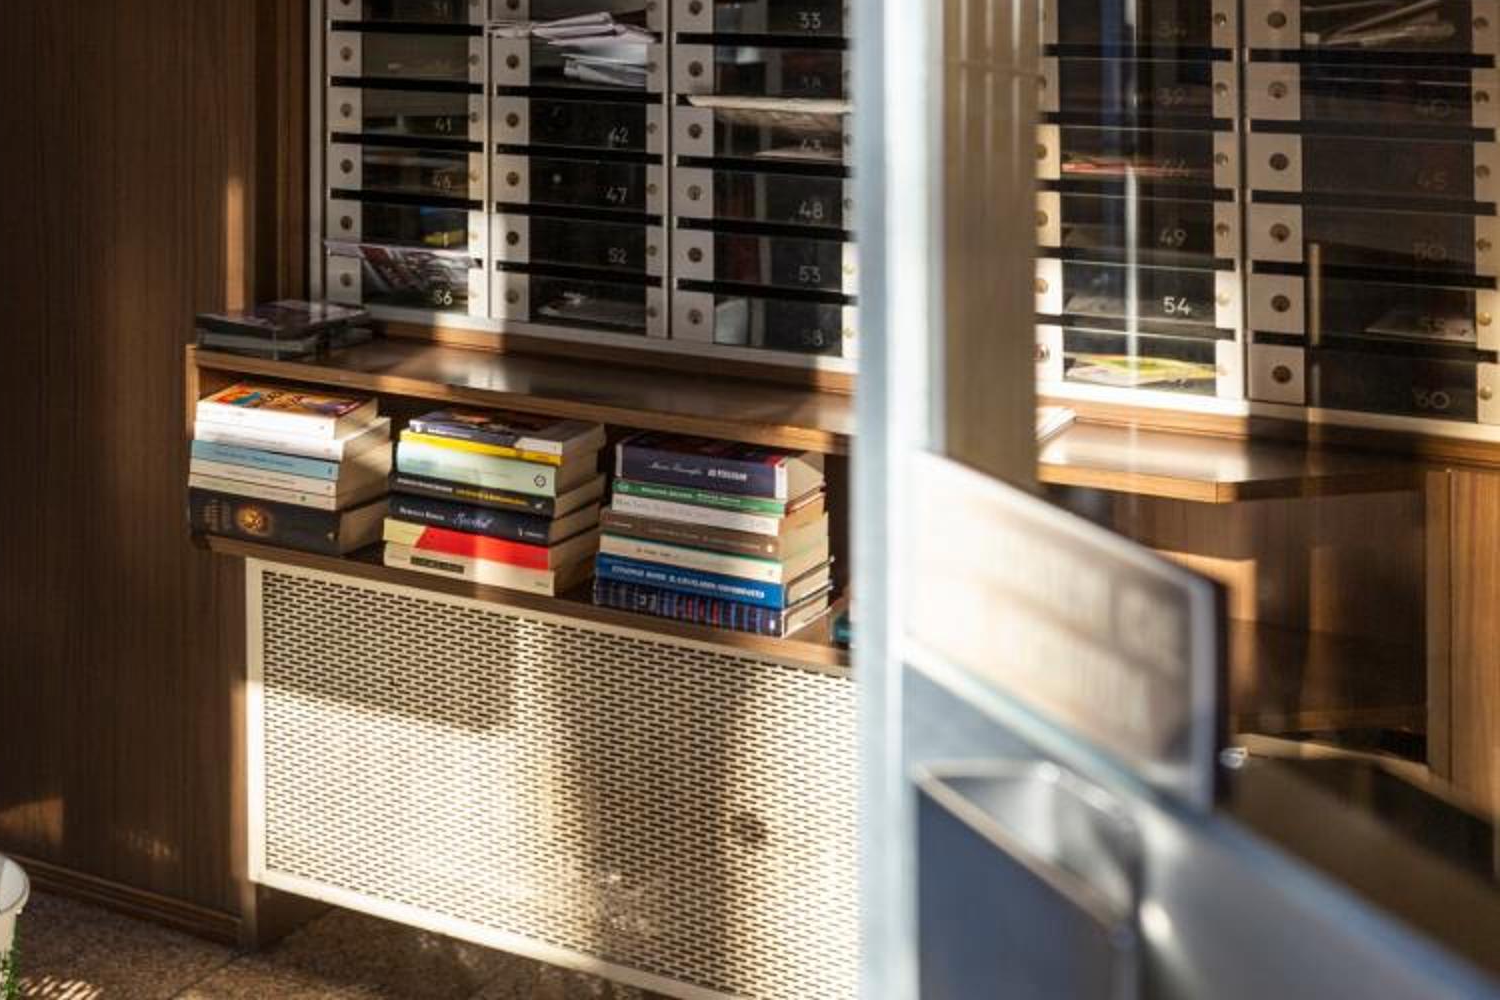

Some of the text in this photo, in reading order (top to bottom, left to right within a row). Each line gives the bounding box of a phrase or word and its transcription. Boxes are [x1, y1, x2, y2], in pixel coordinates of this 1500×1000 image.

[799, 200, 822, 220] 48
[1159, 227, 1187, 248] 49
[608, 246, 627, 265] 52
[798, 264, 820, 283] 53
[434, 290, 452, 306] 56
[1162, 295, 1191, 316] 54
